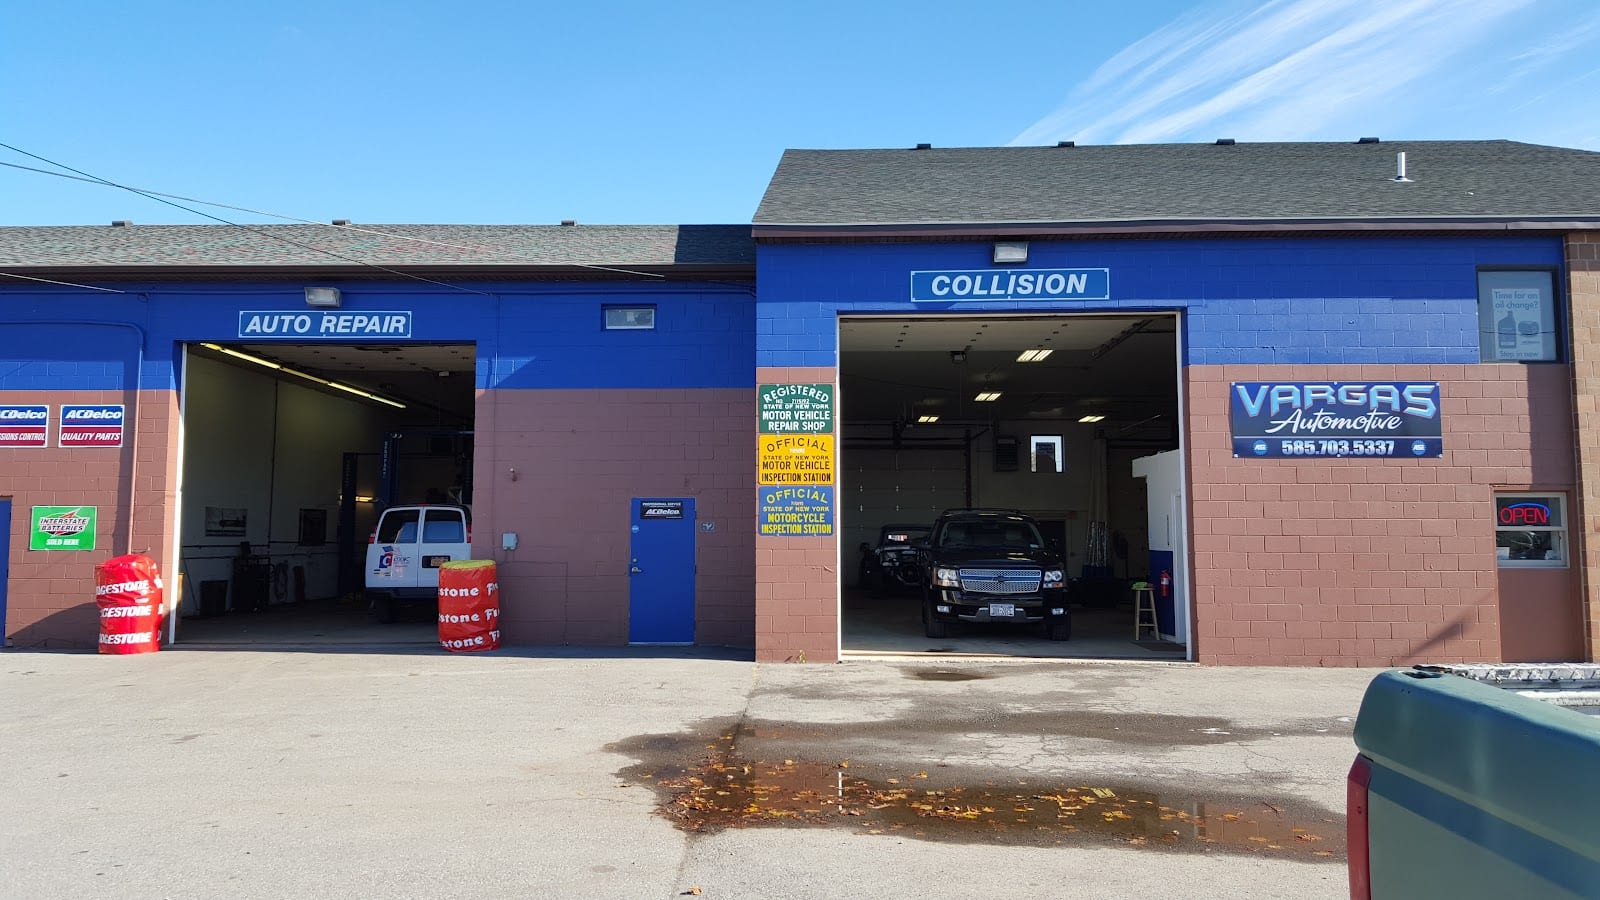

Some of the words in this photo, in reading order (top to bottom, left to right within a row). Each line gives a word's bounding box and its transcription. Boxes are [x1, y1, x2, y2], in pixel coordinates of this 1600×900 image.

[931, 273, 1088, 296] COLLISION
[1495, 291, 1513, 300] Time
[1514, 290, 1525, 300] for
[1527, 292, 1538, 300] an
[1495, 300, 1505, 309] oil
[1506, 300, 1538, 311] change?
[244, 314, 312, 334] AUTO
[319, 314, 406, 334] REPAIR
[762, 385, 829, 403] REGISTERED
[1235, 384, 1437, 419] VARGAS
[65, 409, 122, 419] ACDelco
[762, 410, 792, 420] MOTOR
[793, 410, 831, 420] VEHICLE
[1264, 407, 1403, 434] Automotive
[768, 421, 800, 431] REPAIR
[801, 421, 826, 431] SHOP
[19, 432, 46, 441] CONTROL
[61, 433, 94, 441] QUALITY
[94, 433, 121, 441] PARTS
[766, 437, 828, 452] OFFICIAL
[1281, 440, 1396, 457] 585.703.5337
[762, 461, 791, 470] MOTOR
[794, 461, 830, 470] VEHICLE
[761, 472, 802, 482] INSPECTION
[803, 472, 831, 482] STATION
[766, 488, 828, 504] OFFICIAL
[767, 513, 825, 523] MOTORCYCLE
[1500, 507, 1548, 524] OPEN
[761, 524, 802, 534] INSPECTION
[803, 524, 832, 534] STATION
[46, 538, 62, 546] SOLD
[63, 538, 80, 546] HERE
